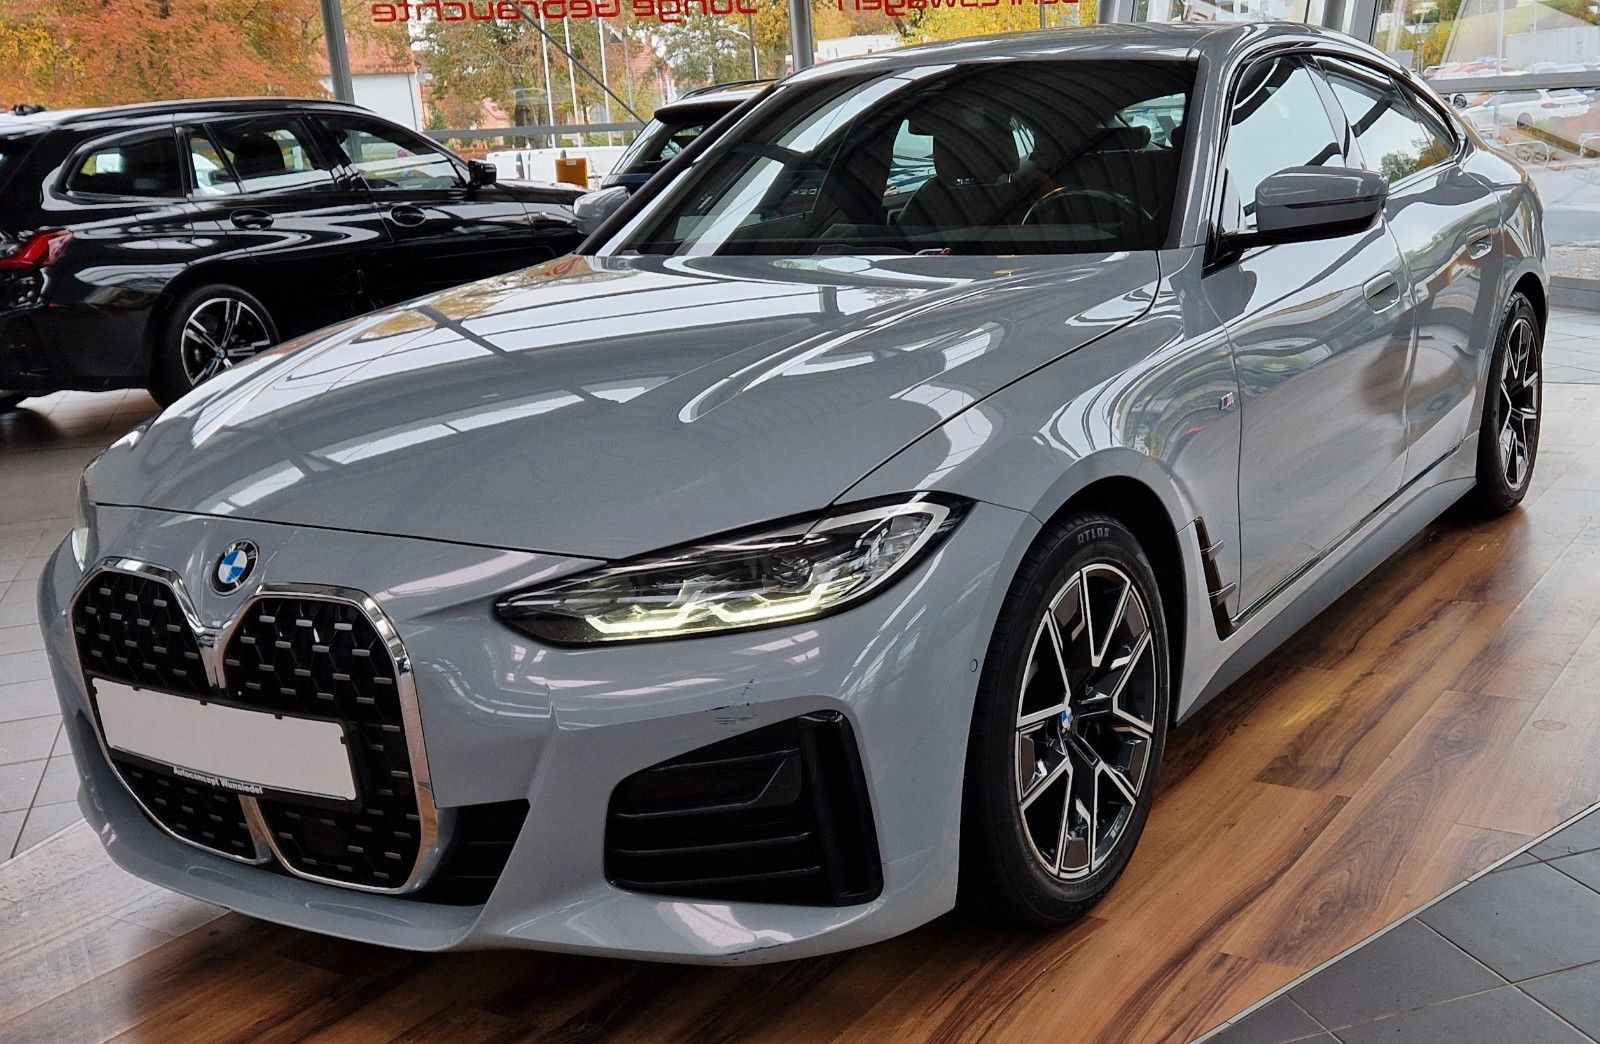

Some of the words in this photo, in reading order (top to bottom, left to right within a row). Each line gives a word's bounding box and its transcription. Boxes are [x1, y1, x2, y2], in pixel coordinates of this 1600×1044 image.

[1077, 527, 1110, 545] ATLAS
[173, 766, 220, 787] Autoconcept
[219, 778, 263, 795] Wunsiedel
